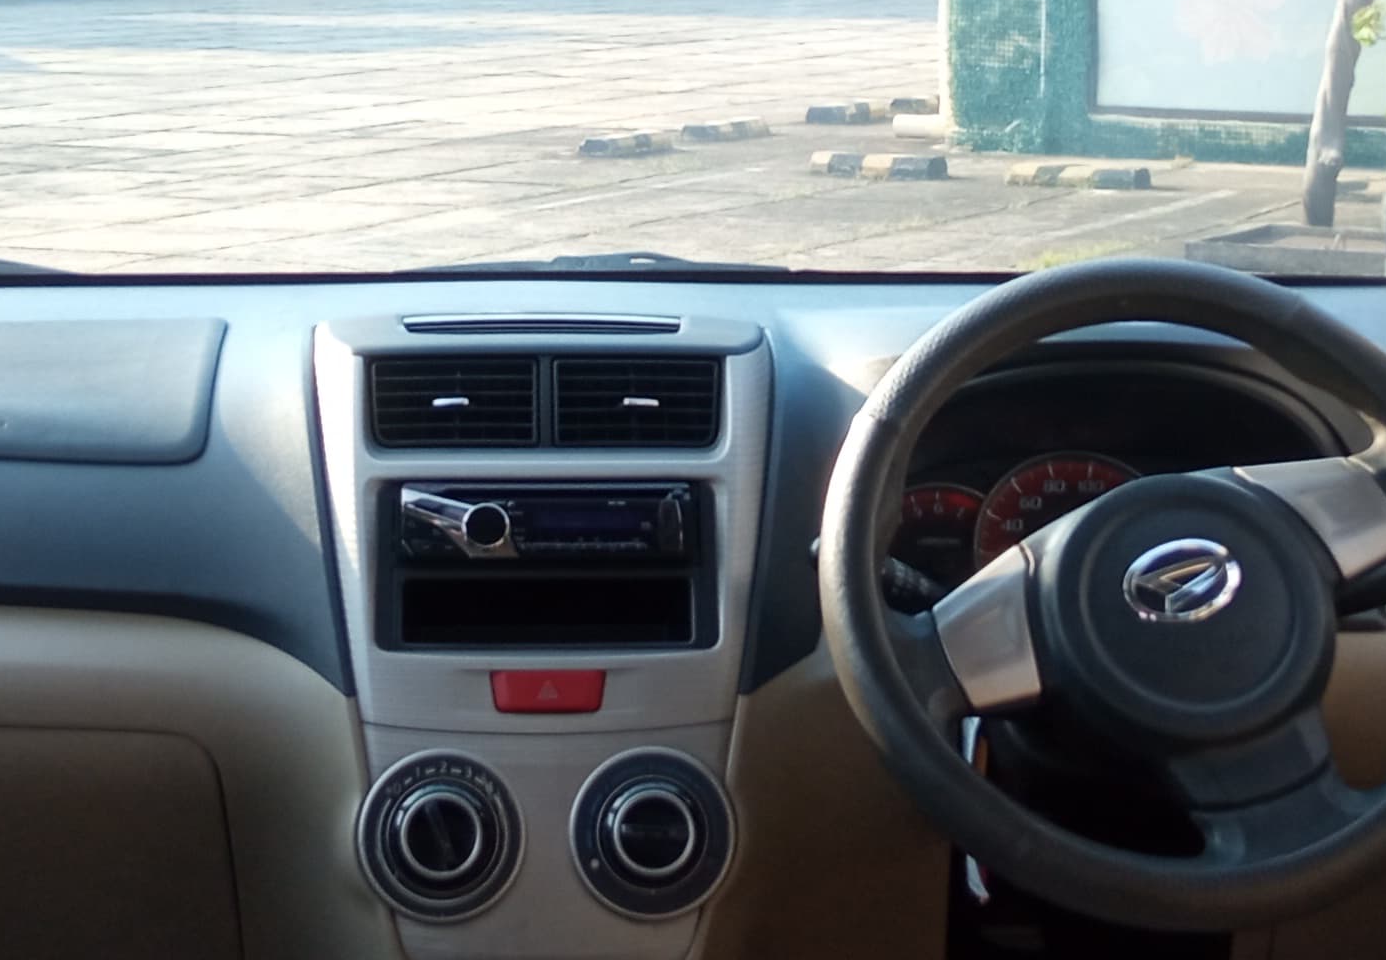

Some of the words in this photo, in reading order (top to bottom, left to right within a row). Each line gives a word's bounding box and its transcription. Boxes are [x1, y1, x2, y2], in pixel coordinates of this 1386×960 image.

[1043, 478, 1066, 492] 80
[933, 500, 944, 514] 6
[1019, 496, 1043, 510] 60
[439, 760, 448, 774] 2
